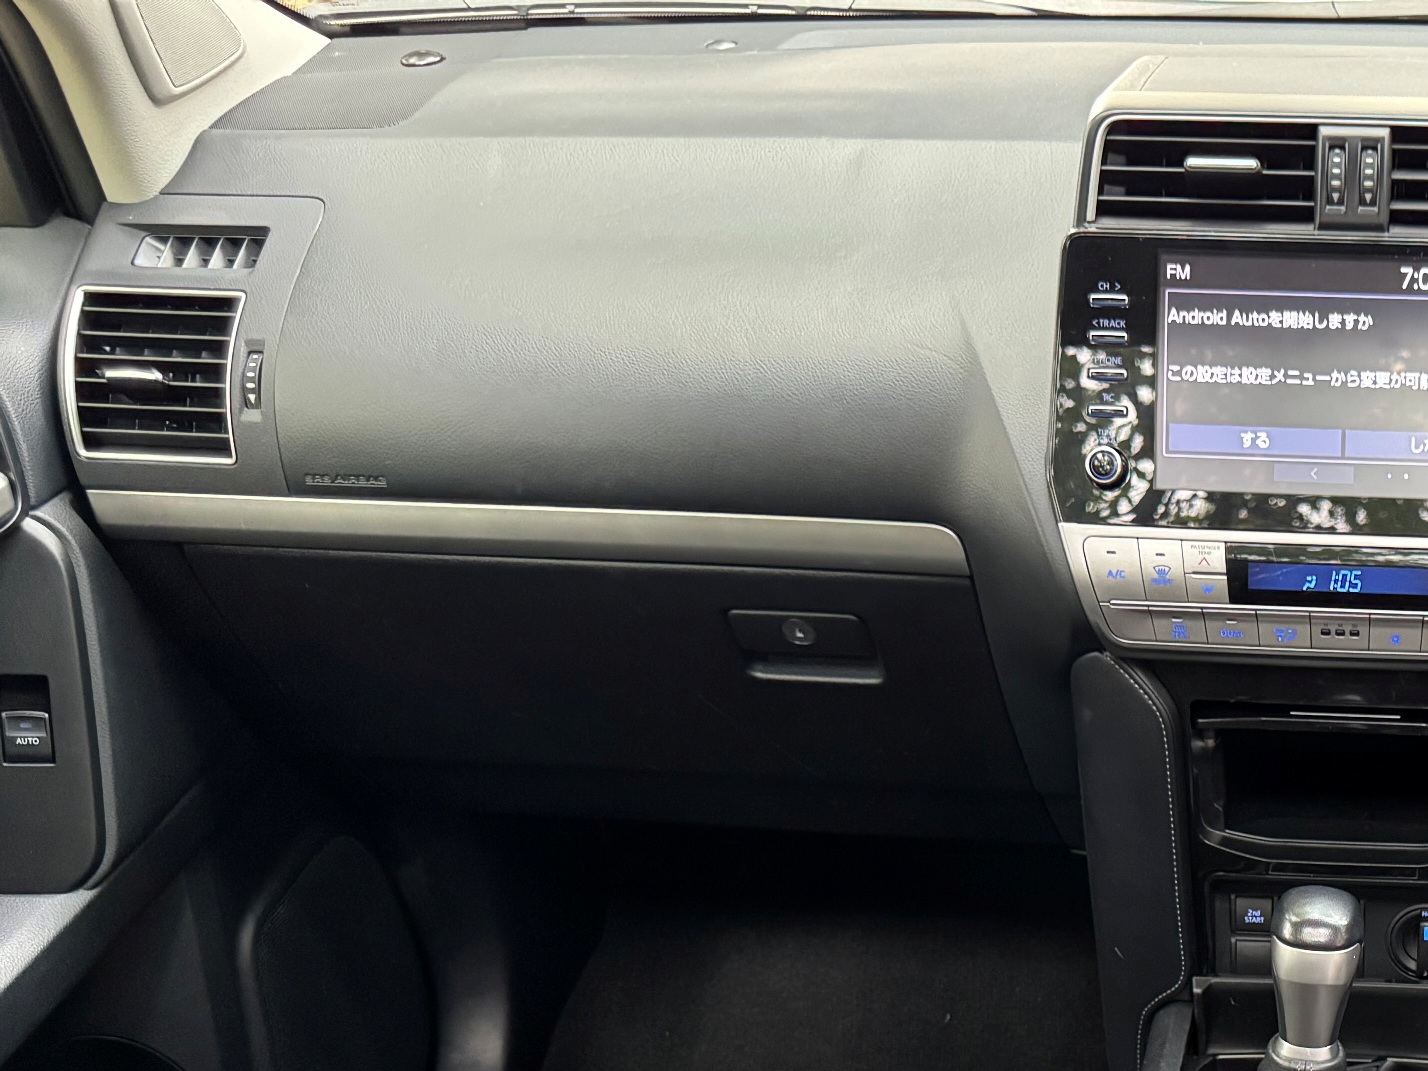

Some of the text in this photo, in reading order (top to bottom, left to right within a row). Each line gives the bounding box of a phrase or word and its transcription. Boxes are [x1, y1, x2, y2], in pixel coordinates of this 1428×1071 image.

[1166, 262, 1191, 280] FM
[1098, 281, 1110, 291] CH
[1100, 318, 1127, 329] TRACK
[1167, 307, 1374, 331] Android Autoを開始しますか
[1094, 356, 1123, 366] PHONE
[1240, 430, 1270, 449] する
[1106, 569, 1126, 580] A/C
[15, 737, 40, 746] AUTO
[1247, 908, 1261, 917] 2nd
[1244, 916, 1265, 924] START
